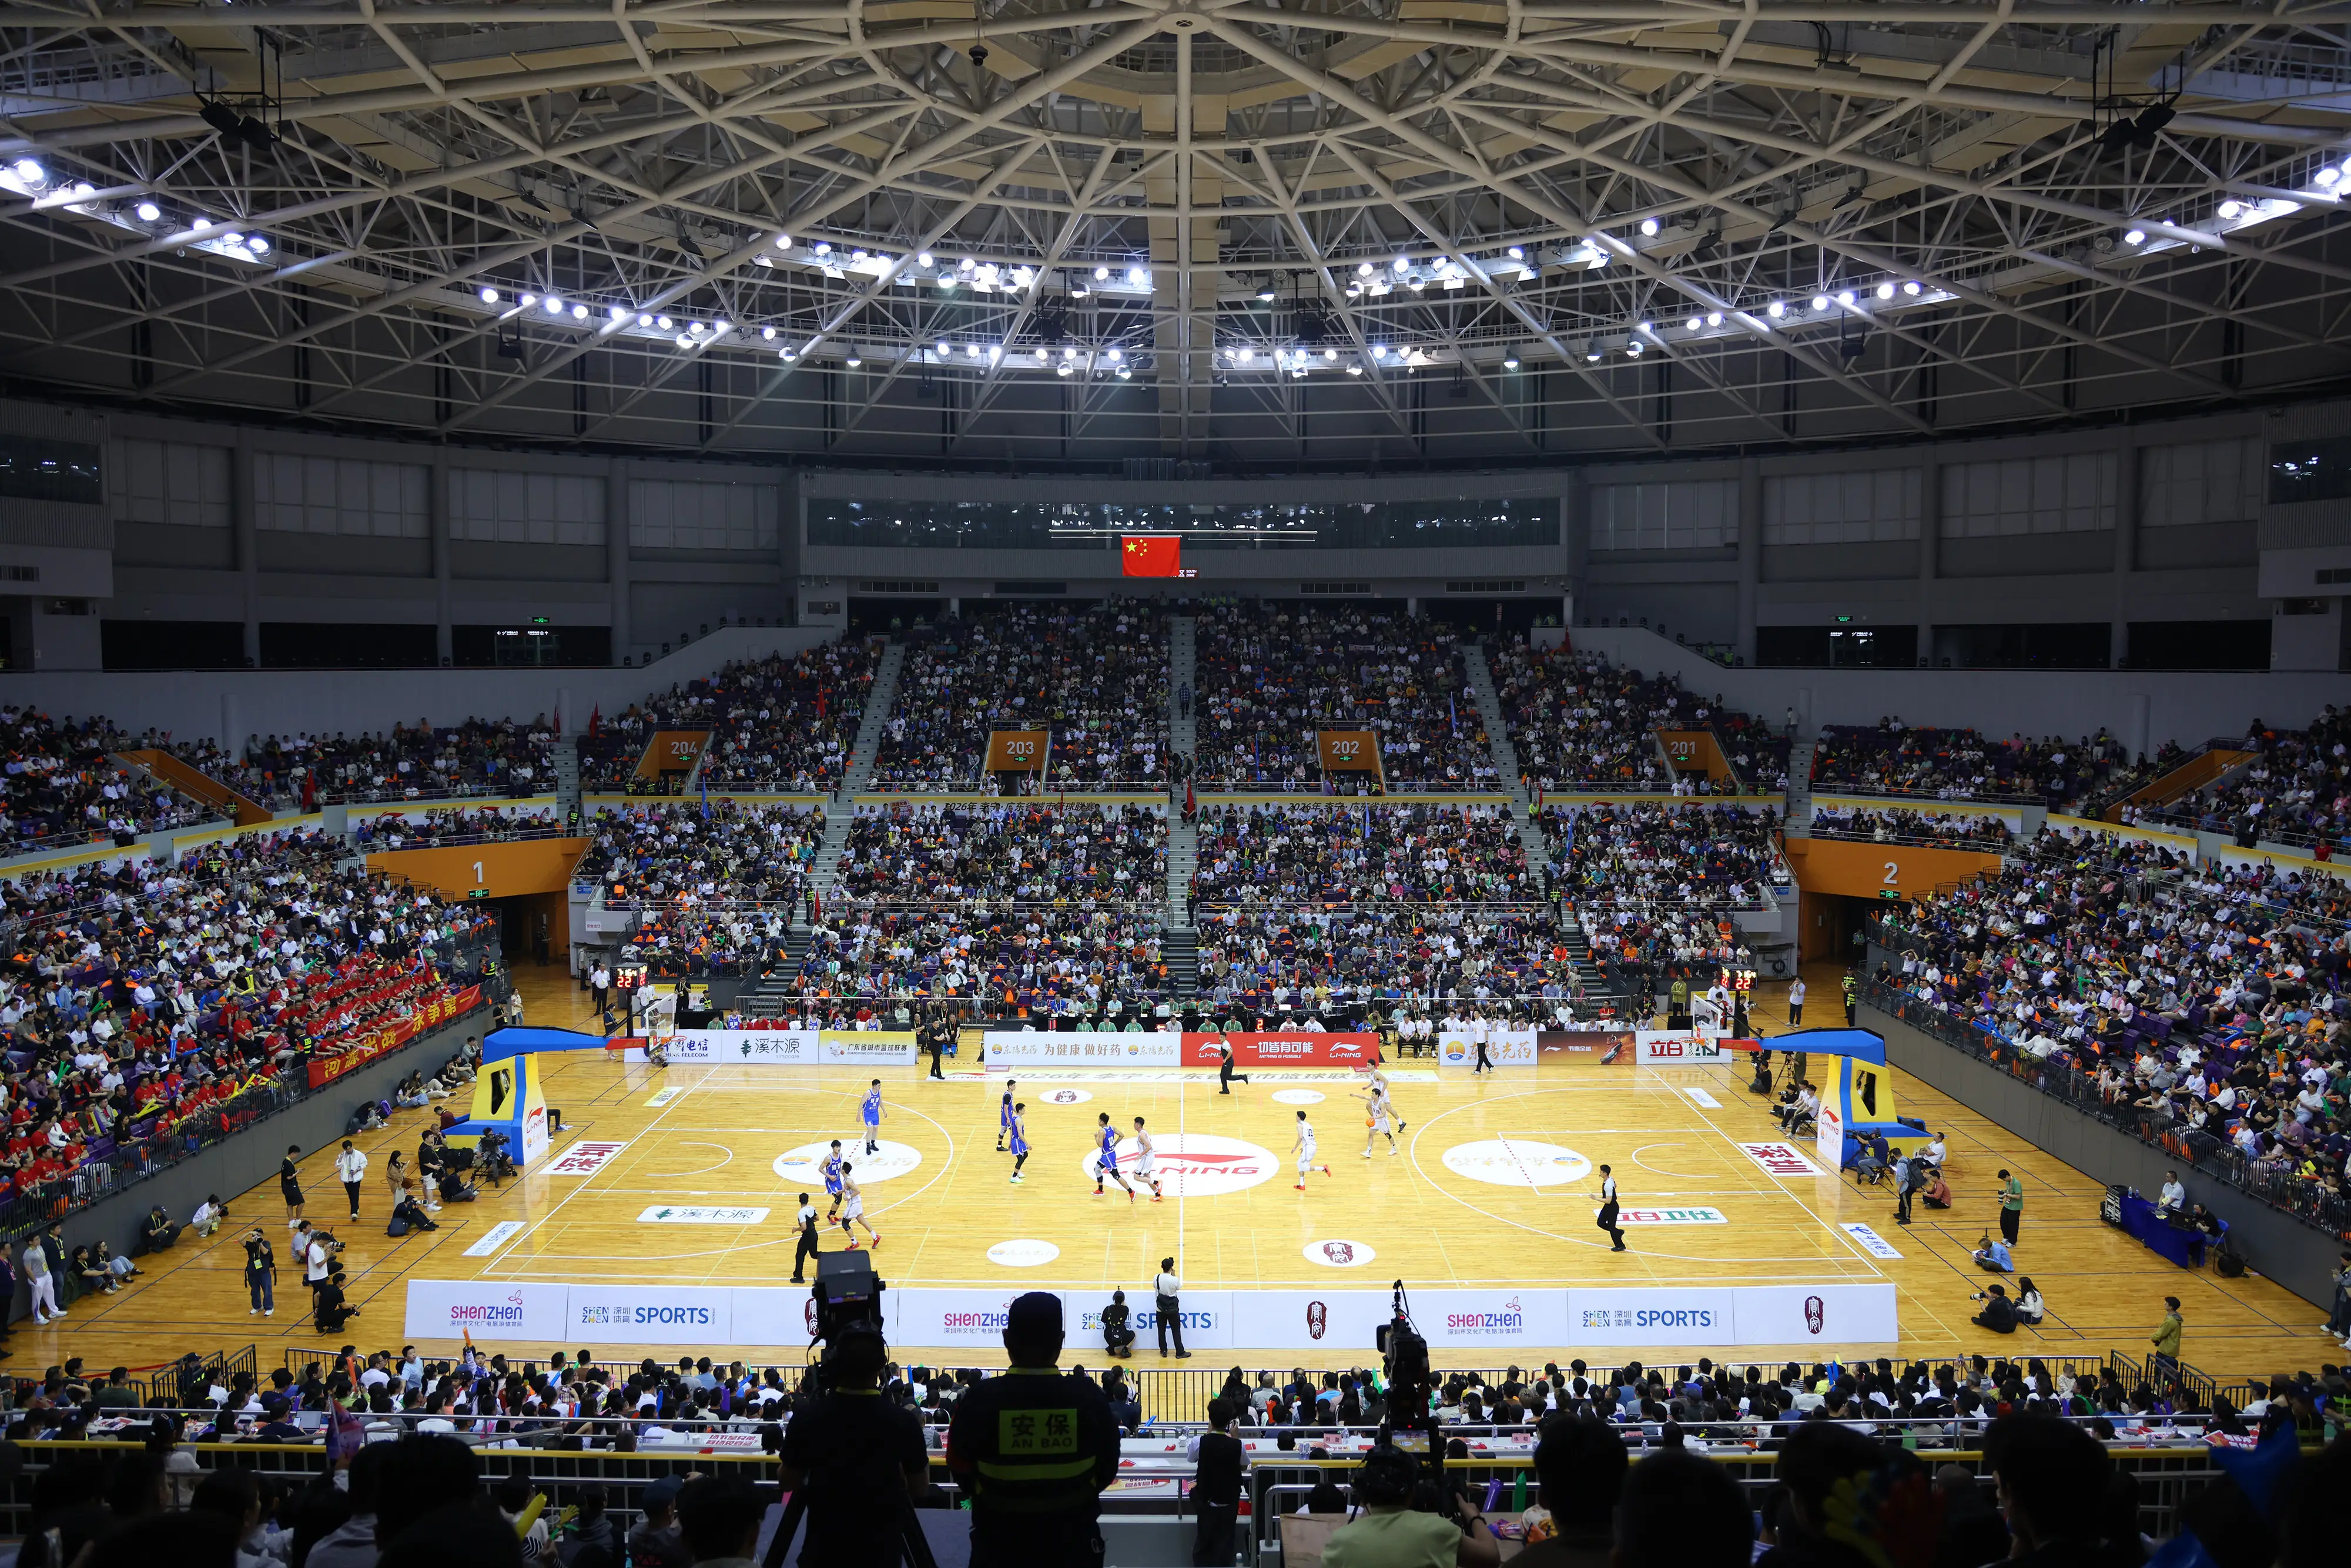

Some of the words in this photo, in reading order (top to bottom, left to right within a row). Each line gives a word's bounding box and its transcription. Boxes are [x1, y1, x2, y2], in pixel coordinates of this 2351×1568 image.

[671, 742, 698, 754] 204
[1007, 741, 1034, 755] 203
[1332, 741, 1359, 754] 202
[1670, 741, 1695, 754] 201
[473, 862, 483, 883] 1
[1884, 862, 1897, 884] 2
[617, 976, 632, 988] 22
[1736, 978, 1751, 990] 22
[411, 993, 471, 1033] 永争第一
[1257, 1018, 1263, 1030] 2
[755, 1038, 800, 1054] 溪木源
[1247, 1042, 1313, 1053] 一切皆有可能
[527, 1117, 545, 1134] LI-NING
[1821, 1117, 1839, 1135] LI-NING
[1108, 1137, 1114, 1145] 10
[1746, 1145, 1814, 1173] 深圳
[678, 1208, 756, 1219] 溪木源
[488, 1224, 516, 1242] SPORTS
[635, 1307, 709, 1324] SPORTS
[1136, 1312, 1211, 1329] SPRTS
[1615, 1319, 1632, 1327] 体育
[1636, 1310, 1711, 1326] SPORTS
[1010, 1413, 1071, 1436] 安保
[1010, 1439, 1033, 1448] AN
[1041, 1438, 1072, 1448] BAO
